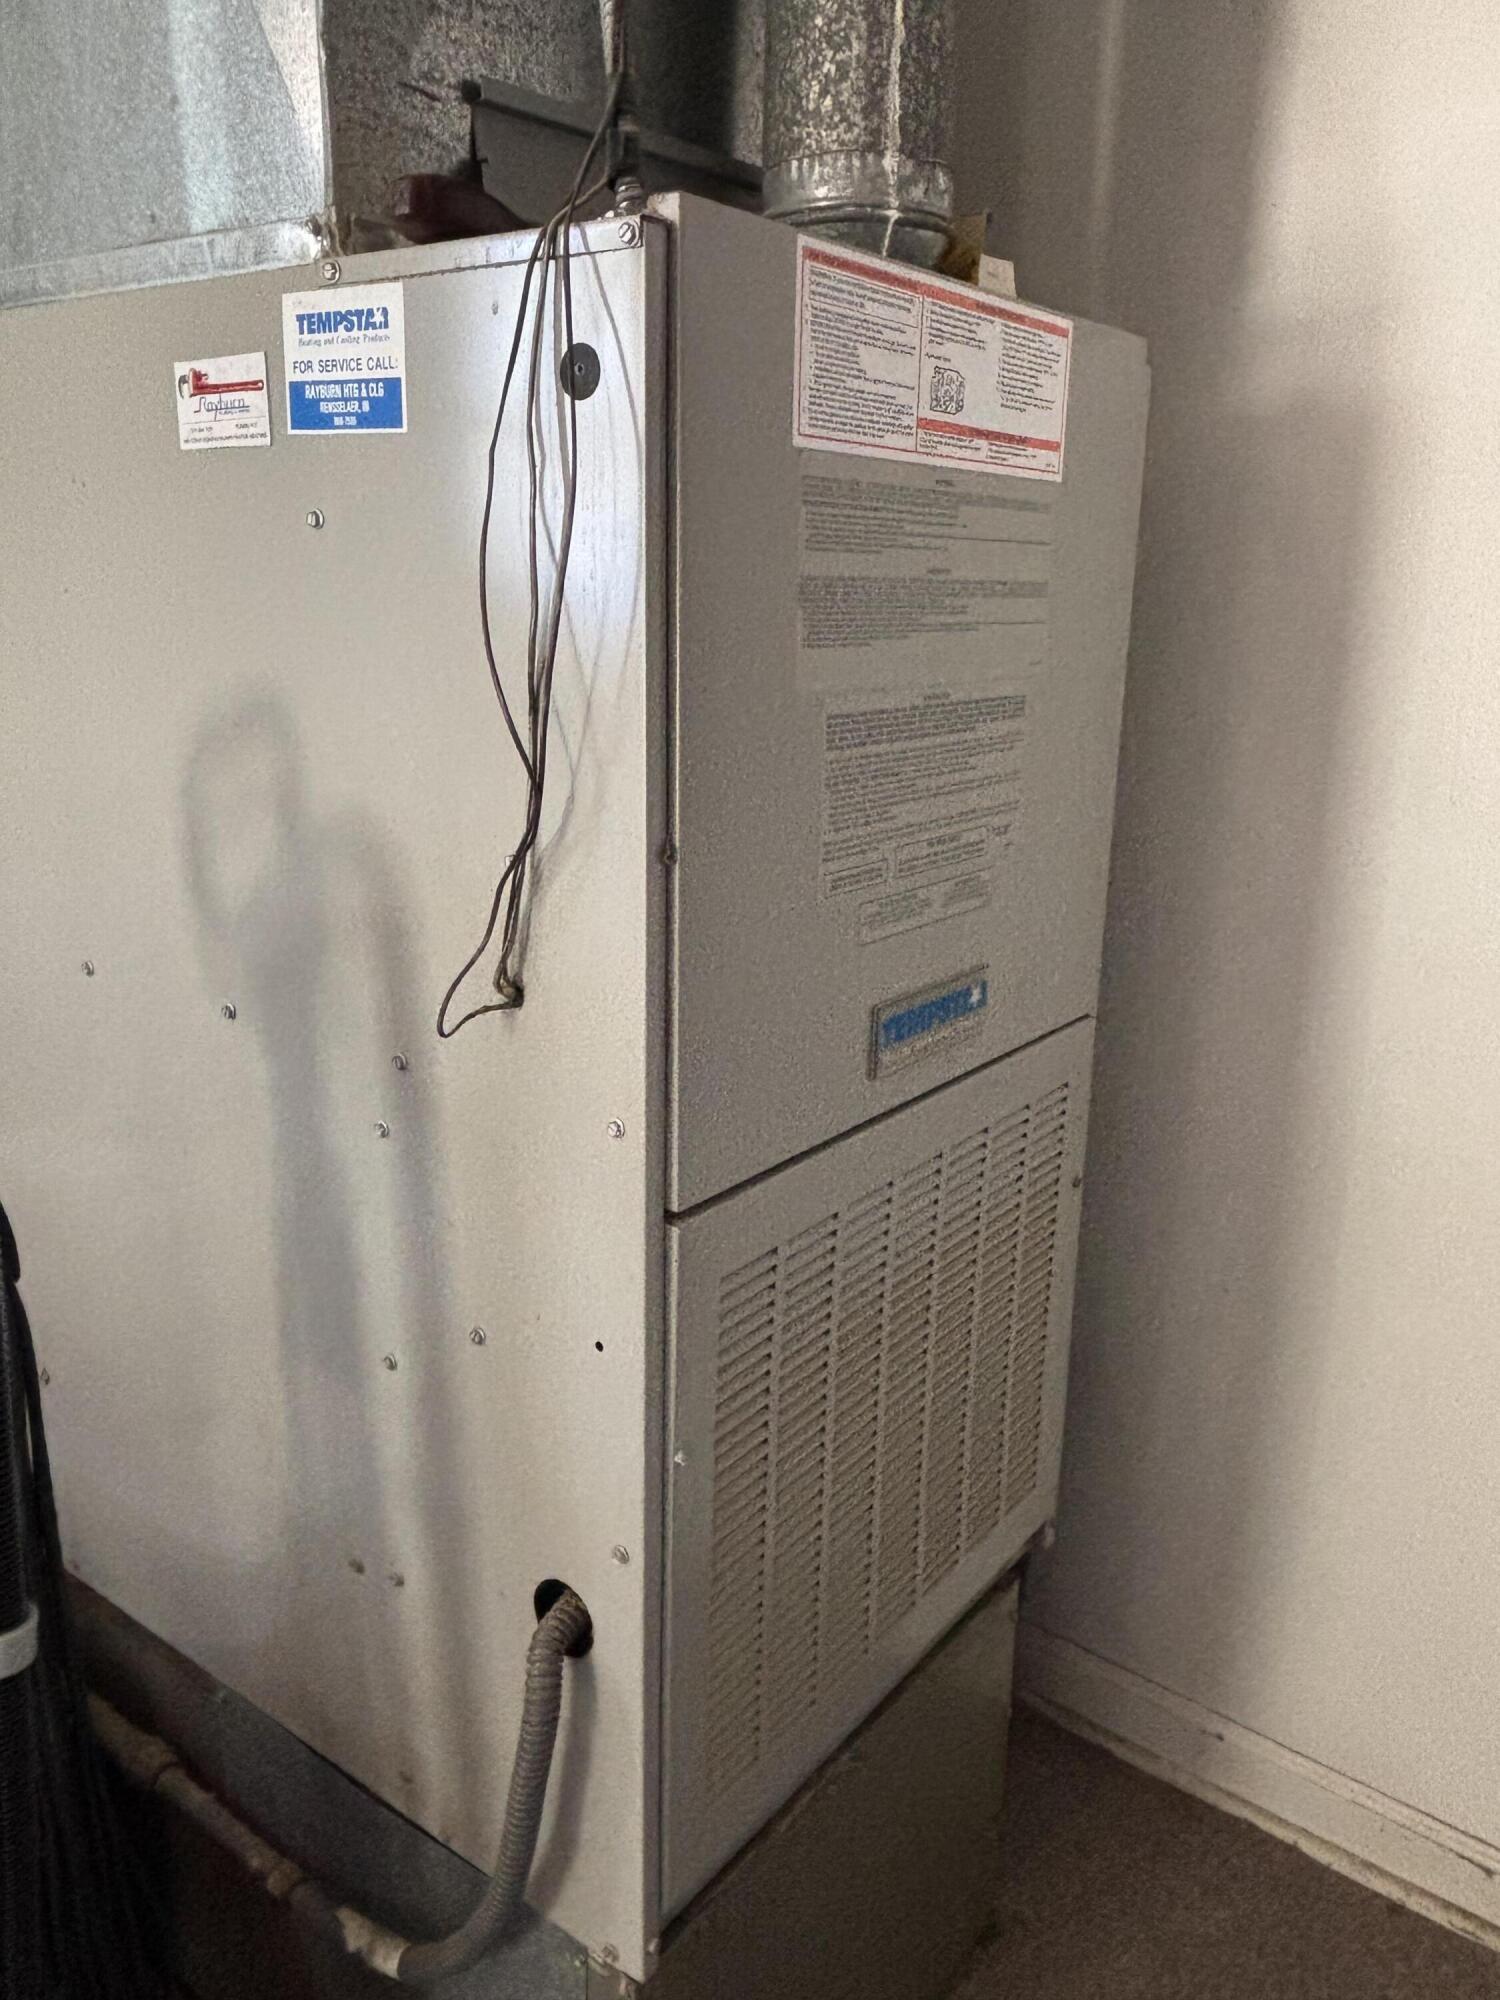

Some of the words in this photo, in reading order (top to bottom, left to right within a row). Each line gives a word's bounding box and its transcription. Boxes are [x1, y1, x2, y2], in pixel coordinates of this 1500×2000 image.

[295, 307, 389, 336] TEMPSTAR
[298, 337, 322, 348] Heating
[323, 336, 335, 346] and
[363, 334, 391, 344] Products
[293, 360, 314, 374] FOR
[318, 357, 363, 373] SERVICE
[367, 355, 399, 371] CALL:
[305, 383, 342, 399] RAYBURN
[343, 382, 359, 398] HTG
[361, 382, 367, 397] &
[369, 381, 385, 397] CLG
